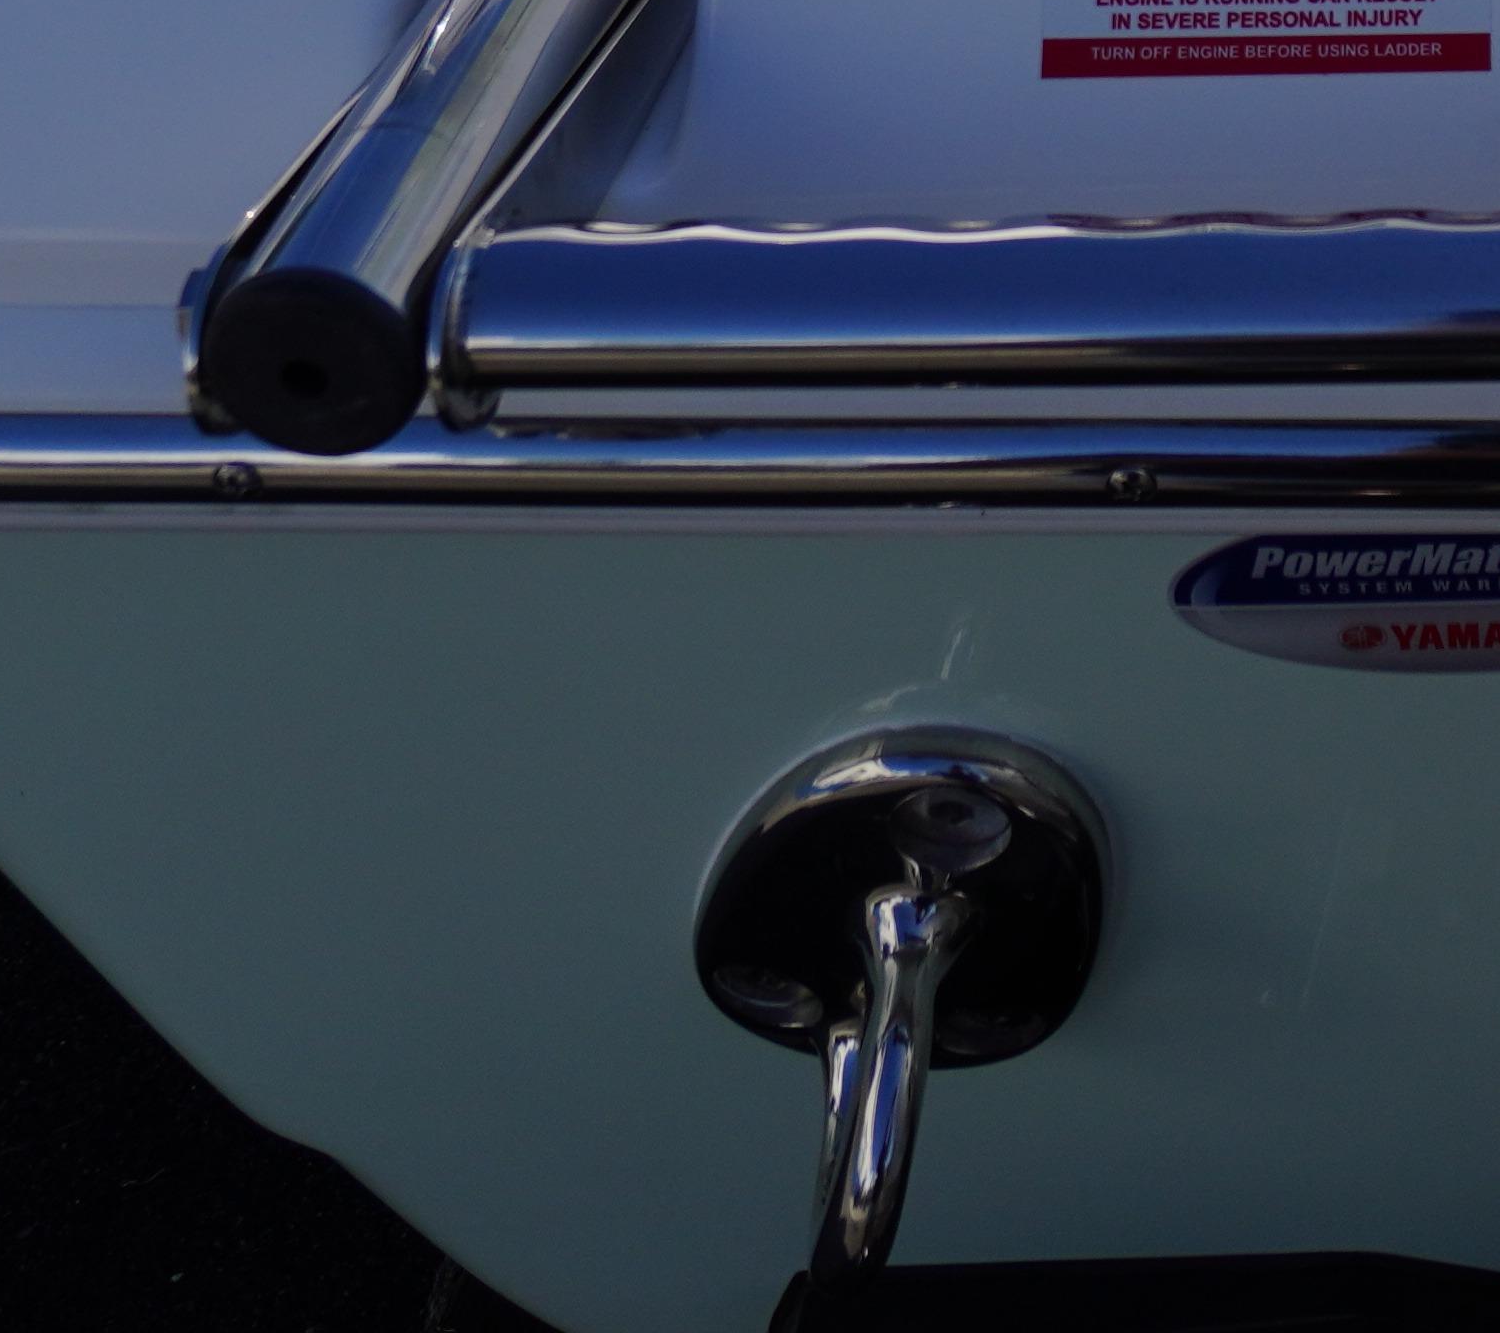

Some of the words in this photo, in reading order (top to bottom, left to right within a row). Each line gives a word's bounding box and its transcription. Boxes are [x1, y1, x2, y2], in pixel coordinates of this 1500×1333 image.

[1111, 13, 1131, 30] IN
[1137, 12, 1221, 30] SEVERE
[1227, 11, 1342, 29] PERSONAL
[1347, 9, 1424, 27] INJURY
[1091, 46, 1136, 61] TURN
[1140, 46, 1173, 60] OFF
[1177, 45, 1240, 60] ENGINE
[1245, 44, 1313, 59] BEFORE
[1317, 44, 1369, 59] USING
[1375, 42, 1443, 58] LADDER
[1299, 579, 1414, 596] SYSTEM
